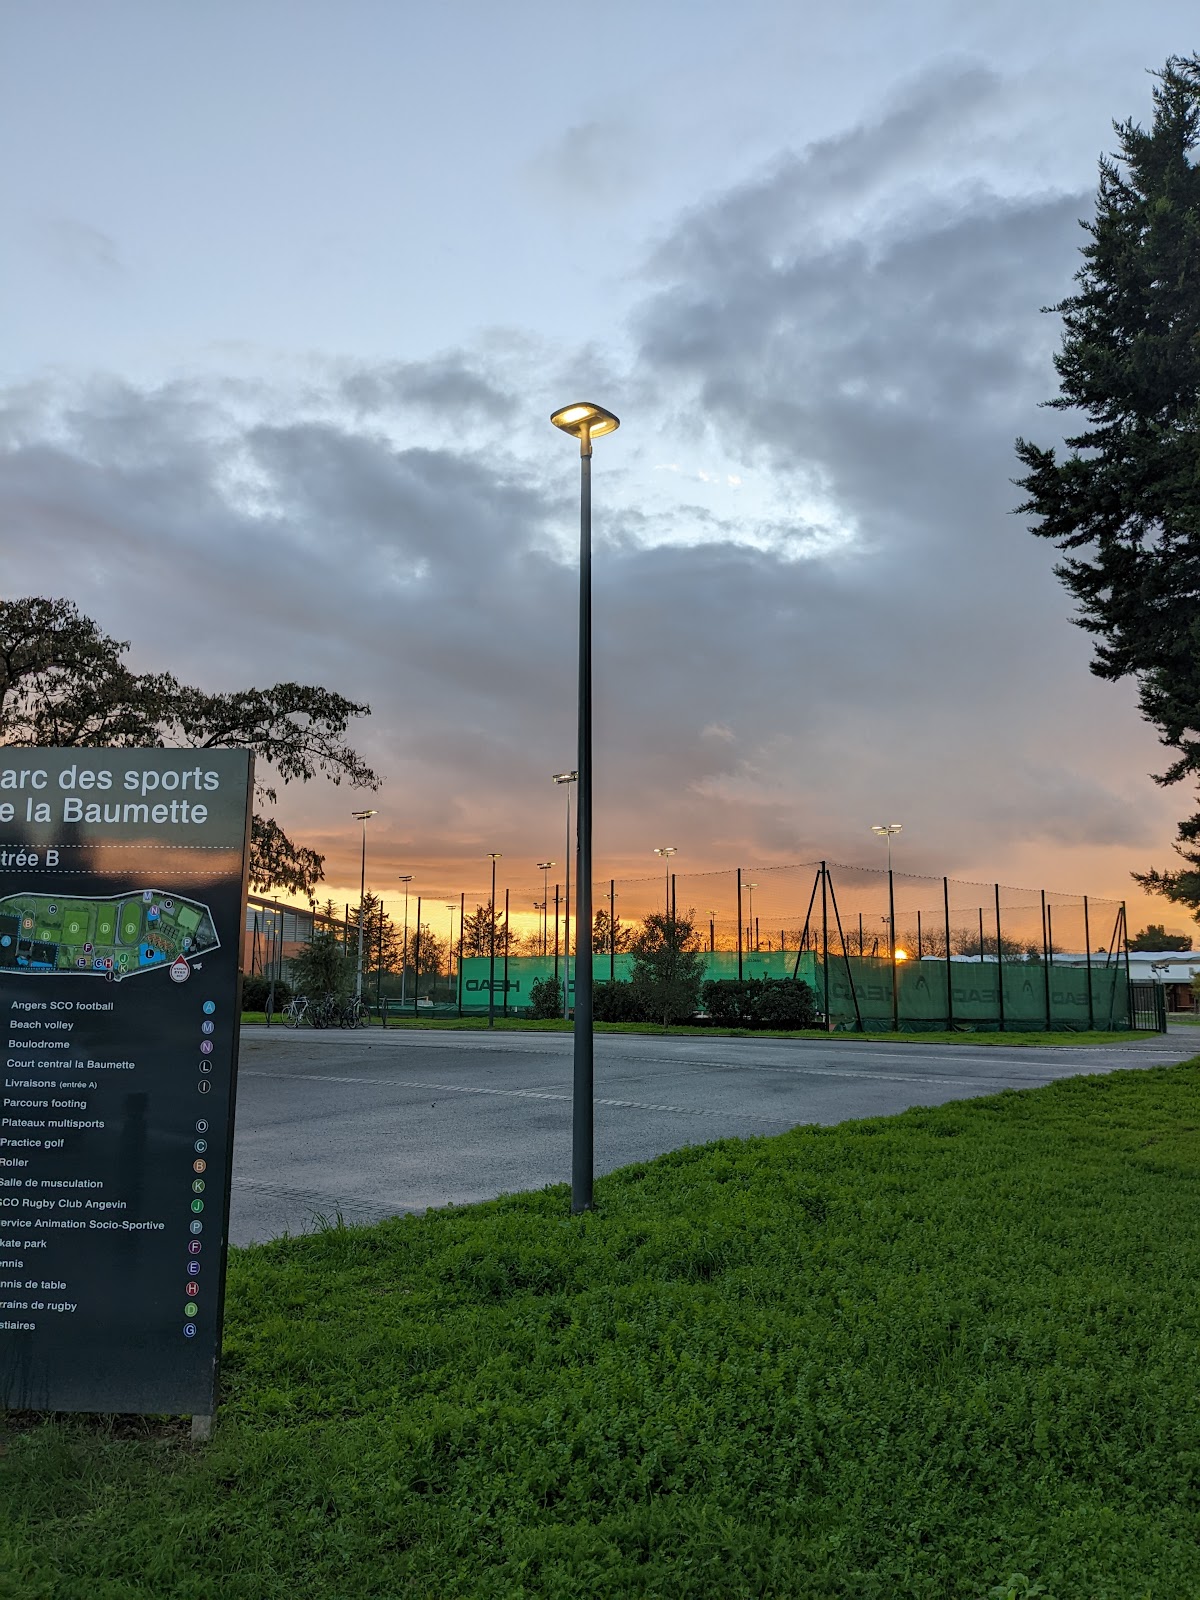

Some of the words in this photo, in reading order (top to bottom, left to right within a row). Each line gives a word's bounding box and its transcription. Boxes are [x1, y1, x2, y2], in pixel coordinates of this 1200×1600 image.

[1, 770, 47, 789] arc
[59, 765, 112, 789] des
[124, 767, 219, 796] sports
[0, 803, 14, 822] e
[27, 798, 51, 822] la
[64, 798, 207, 823] Baumette
[1, 849, 38, 866] trée
[46, 850, 59, 866] B
[10, 1001, 47, 1012] Angers
[49, 1002, 74, 1010] SCO
[75, 1002, 114, 1011] football
[9, 1021, 42, 1029] Beach
[44, 1021, 74, 1032] volley
[8, 1040, 71, 1049] Boulodrome
[6, 1059, 36, 1068] Court
[37, 1060, 72, 1069] central
[74, 1060, 84, 1069] la
[86, 1061, 136, 1070] Baumette
[5, 1079, 57, 1088] Livraisons
[59, 1081, 87, 1089] (entrée
[88, 1081, 98, 1090] A)
[3, 1099, 49, 1108] Parcours
[51, 1099, 87, 1110] footing
[1, 1118, 46, 1127] Plateaux
[47, 1119, 105, 1130] multisports
[0, 1138, 42, 1147] Practice
[44, 1139, 65, 1149] golf
[24, 1179, 39, 1188] de
[40, 1180, 104, 1189] musculation
[22, 1199, 56, 1210] Rugby
[58, 1199, 83, 1209] Club
[84, 1200, 127, 1211] Angevin
[0, 1219, 32, 1228] ervice
[34, 1219, 87, 1229] Animation
[89, 1220, 165, 1232] Socio-Sportive
[0, 1239, 22, 1248] kate
[23, 1240, 47, 1250] park
[0, 1260, 24, 1268] nnis
[0, 1280, 22, 1289] nnis
[24, 1281, 39, 1289] de
[40, 1281, 67, 1290] table
[0, 1301, 29, 1310] rrains
[30, 1302, 45, 1310] de
[47, 1302, 78, 1313] rugby
[0, 1321, 36, 1331] stiaires
